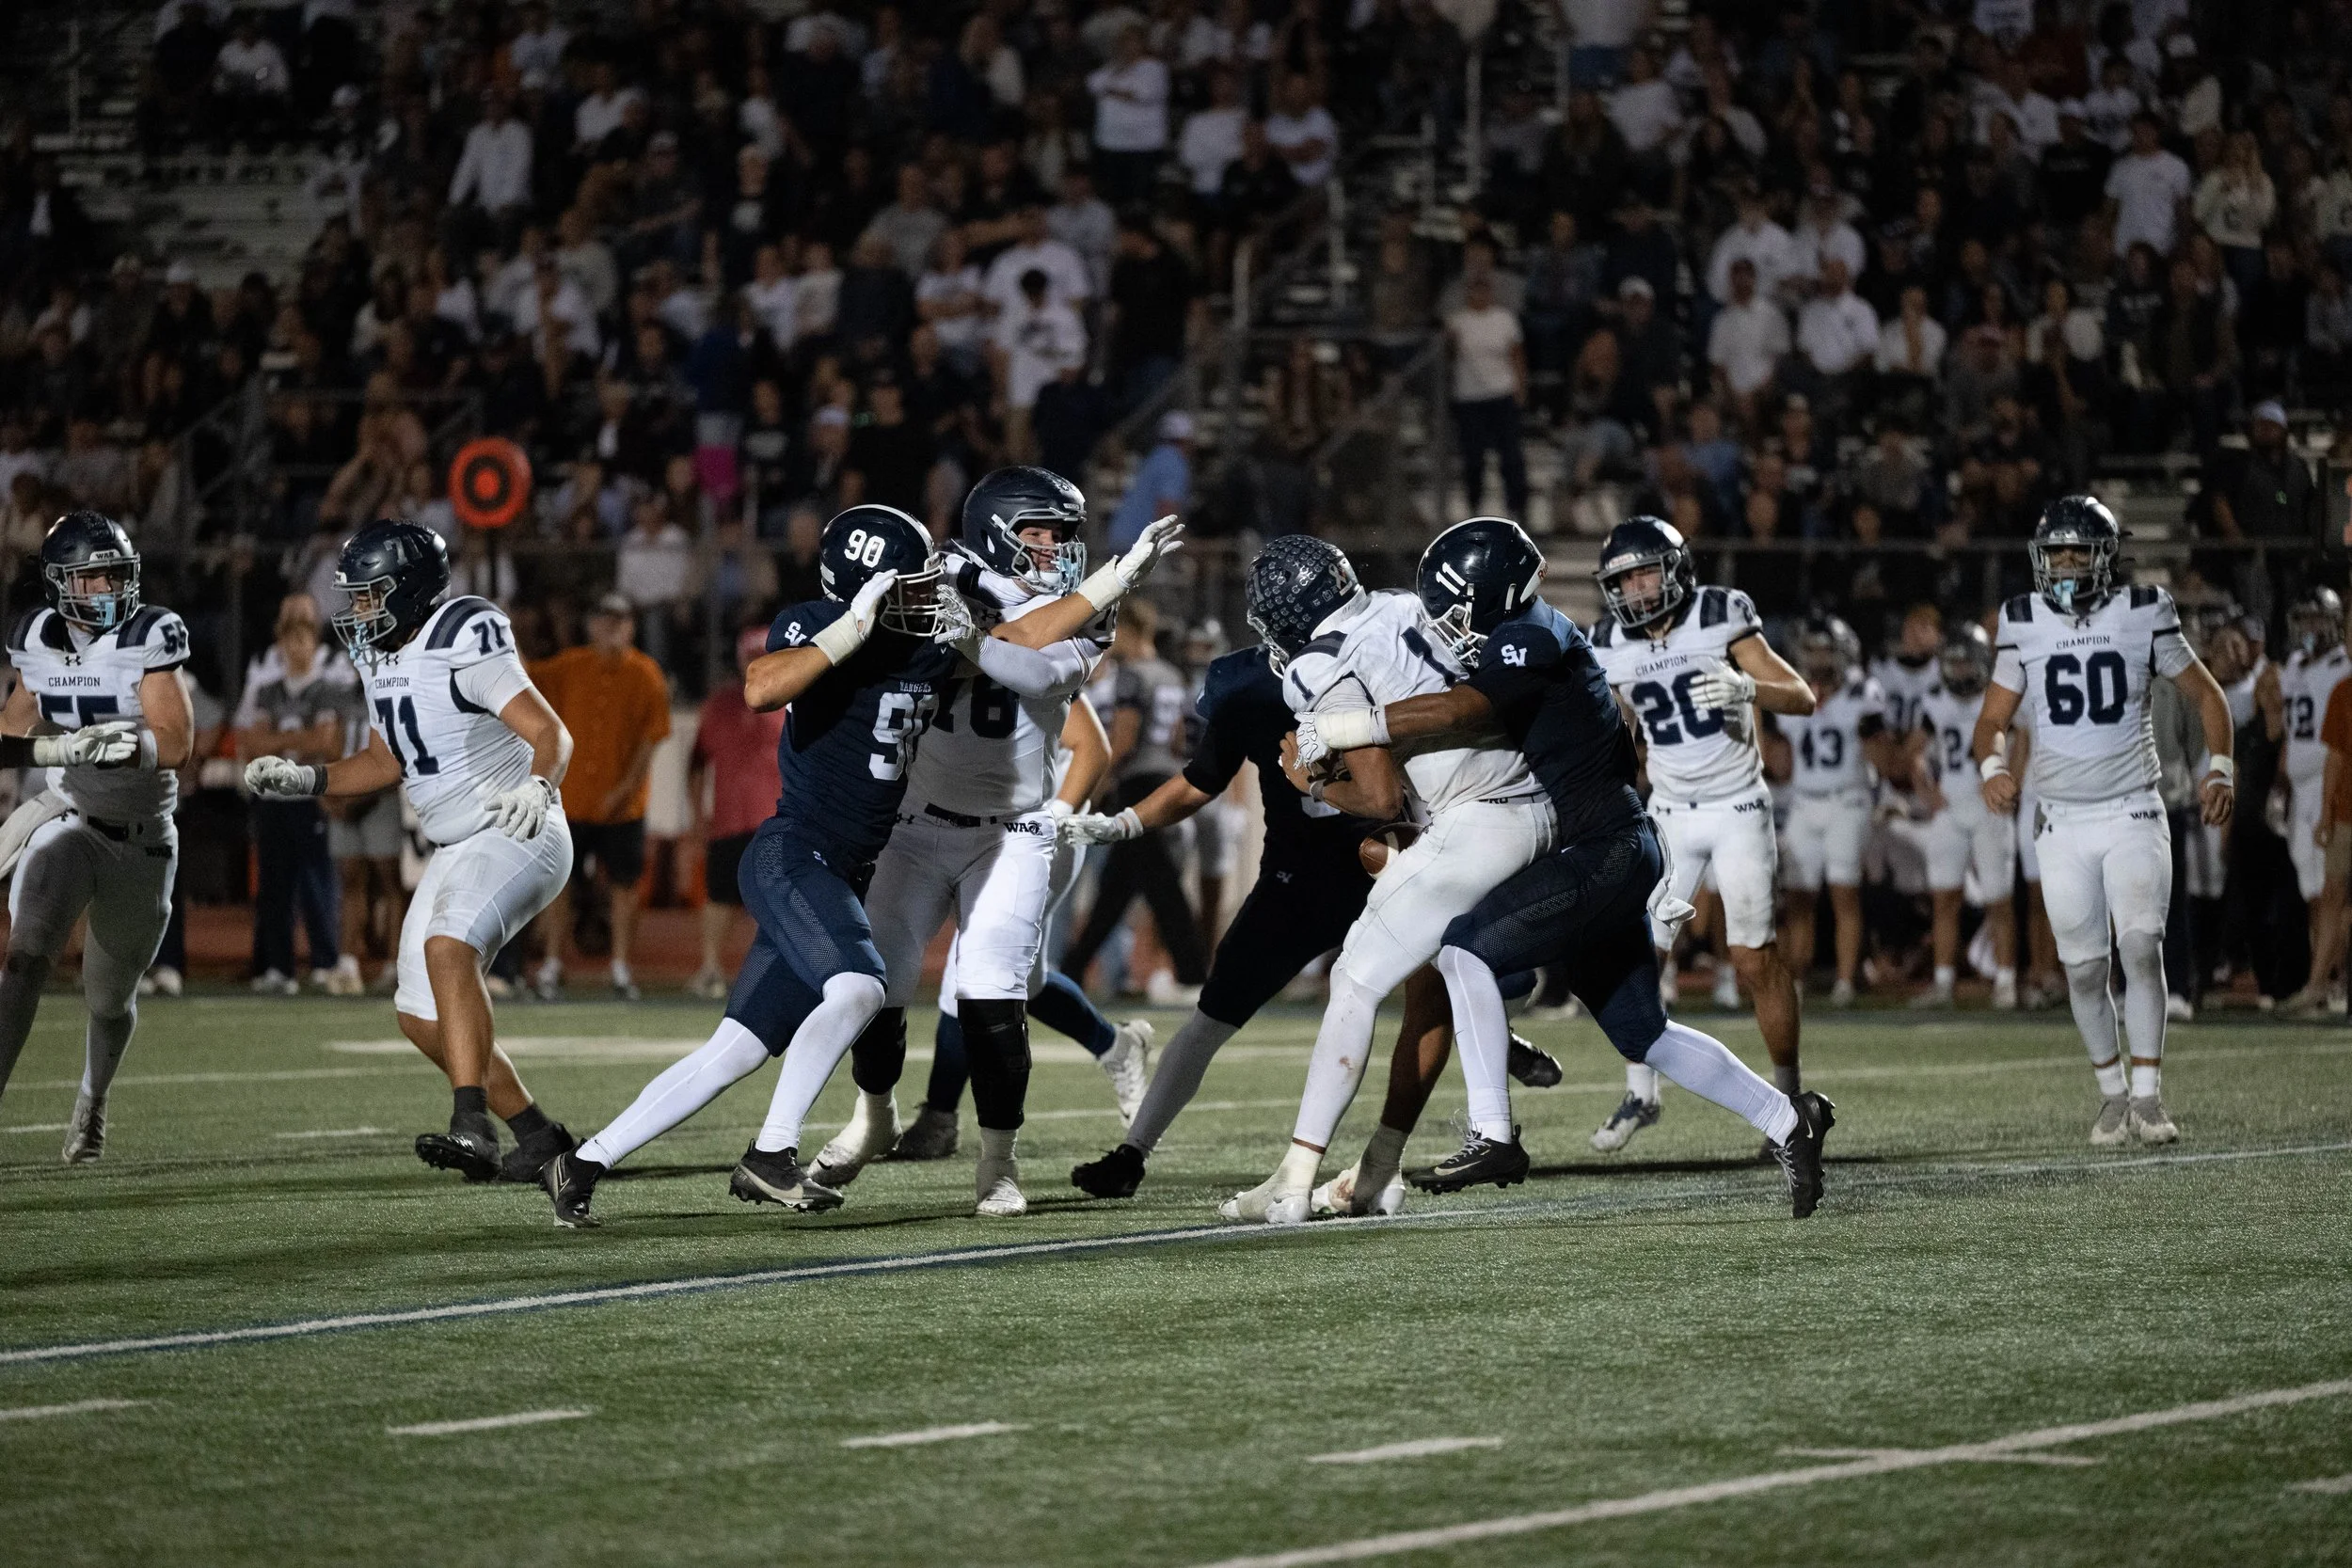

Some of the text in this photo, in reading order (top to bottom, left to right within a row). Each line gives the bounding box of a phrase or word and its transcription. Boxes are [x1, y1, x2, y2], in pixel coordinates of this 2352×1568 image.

[844, 529, 885, 568] 90
[1436, 562, 1467, 596] 11
[159, 621, 188, 655] 55
[470, 618, 507, 656] 71
[785, 621, 807, 646] SV
[2056, 635, 2110, 650] CHAMPION
[1501, 643, 1527, 667] SV
[1635, 655, 1688, 677] CHAMPION
[48, 676, 101, 688] CHAMPION
[374, 676, 409, 689] CHAMPION
[1291, 668, 1315, 702] 1
[2045, 651, 2128, 725] 60
[374, 695, 440, 778] 71
